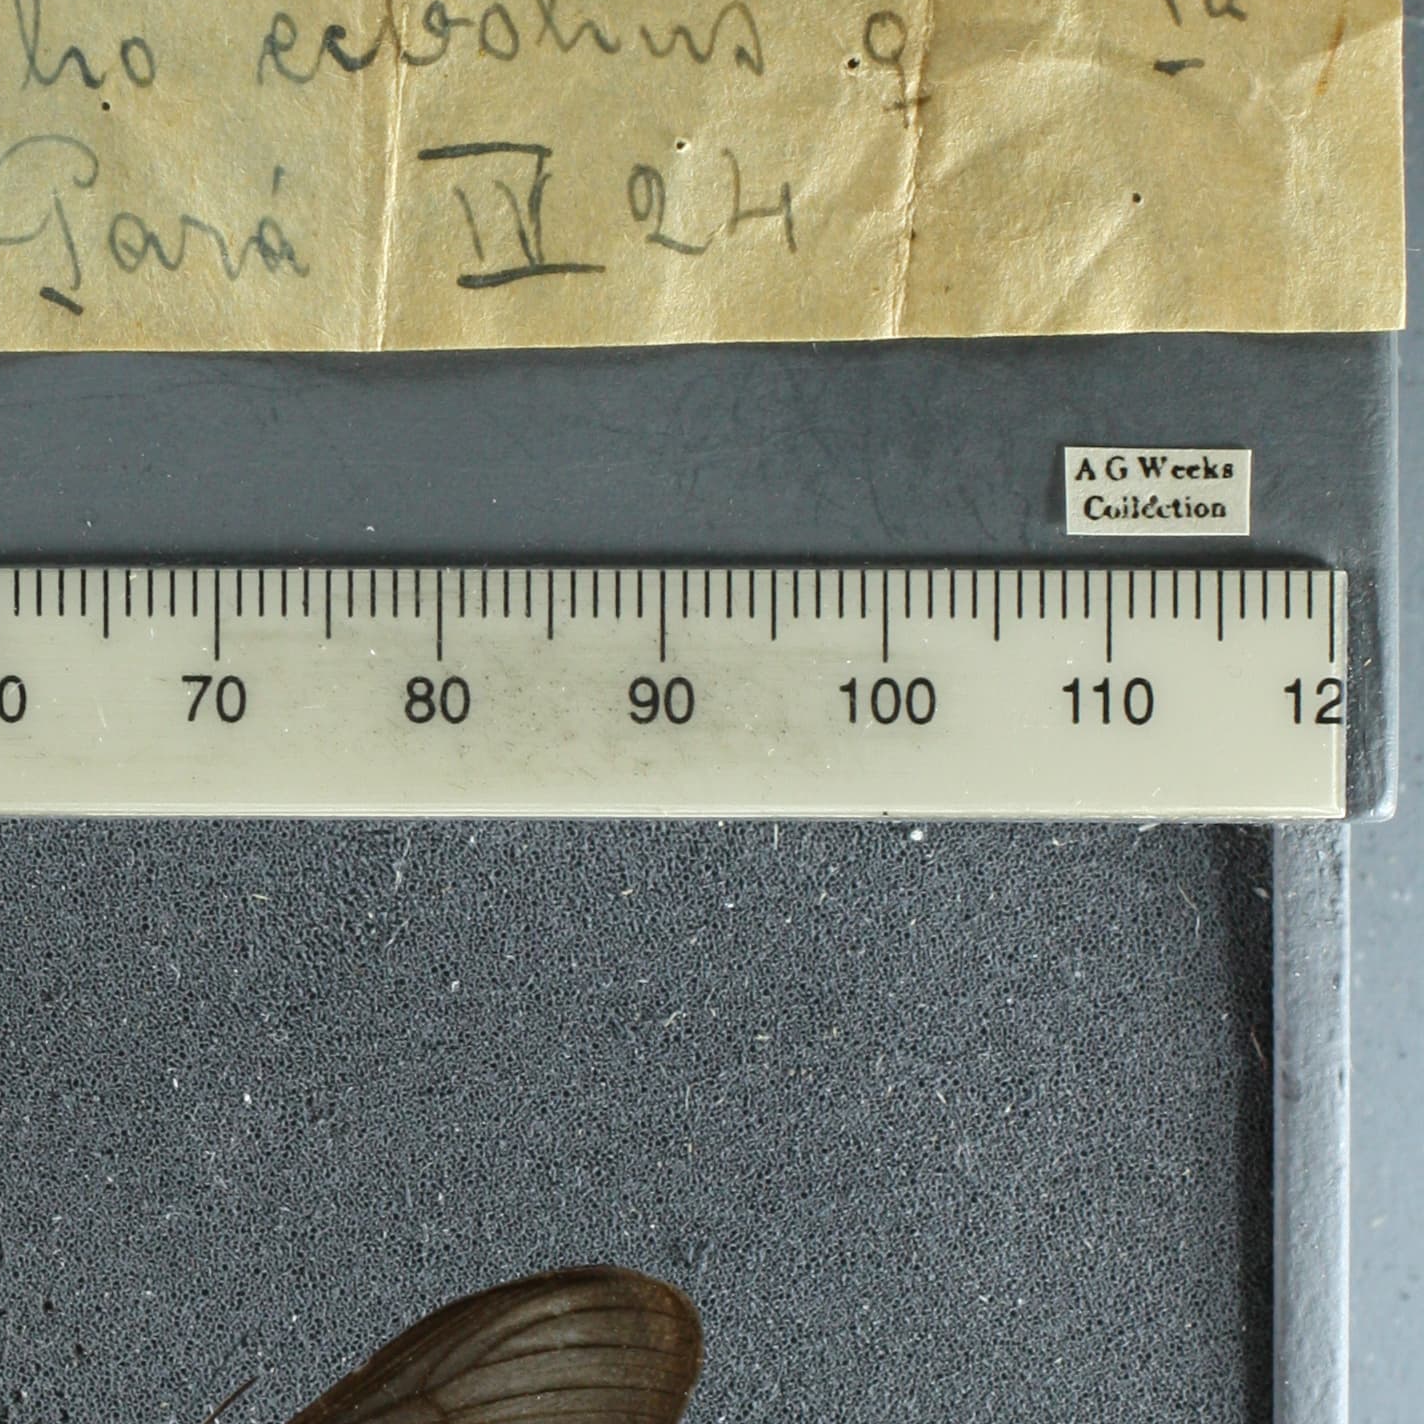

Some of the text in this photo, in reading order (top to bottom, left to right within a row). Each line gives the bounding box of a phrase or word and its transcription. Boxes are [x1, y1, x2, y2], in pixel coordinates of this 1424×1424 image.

[181, 674, 247, 724] 70
[404, 675, 471, 725] 80
[628, 675, 696, 725] 90
[839, 676, 937, 726] 100
[1062, 676, 1154, 726] 110
